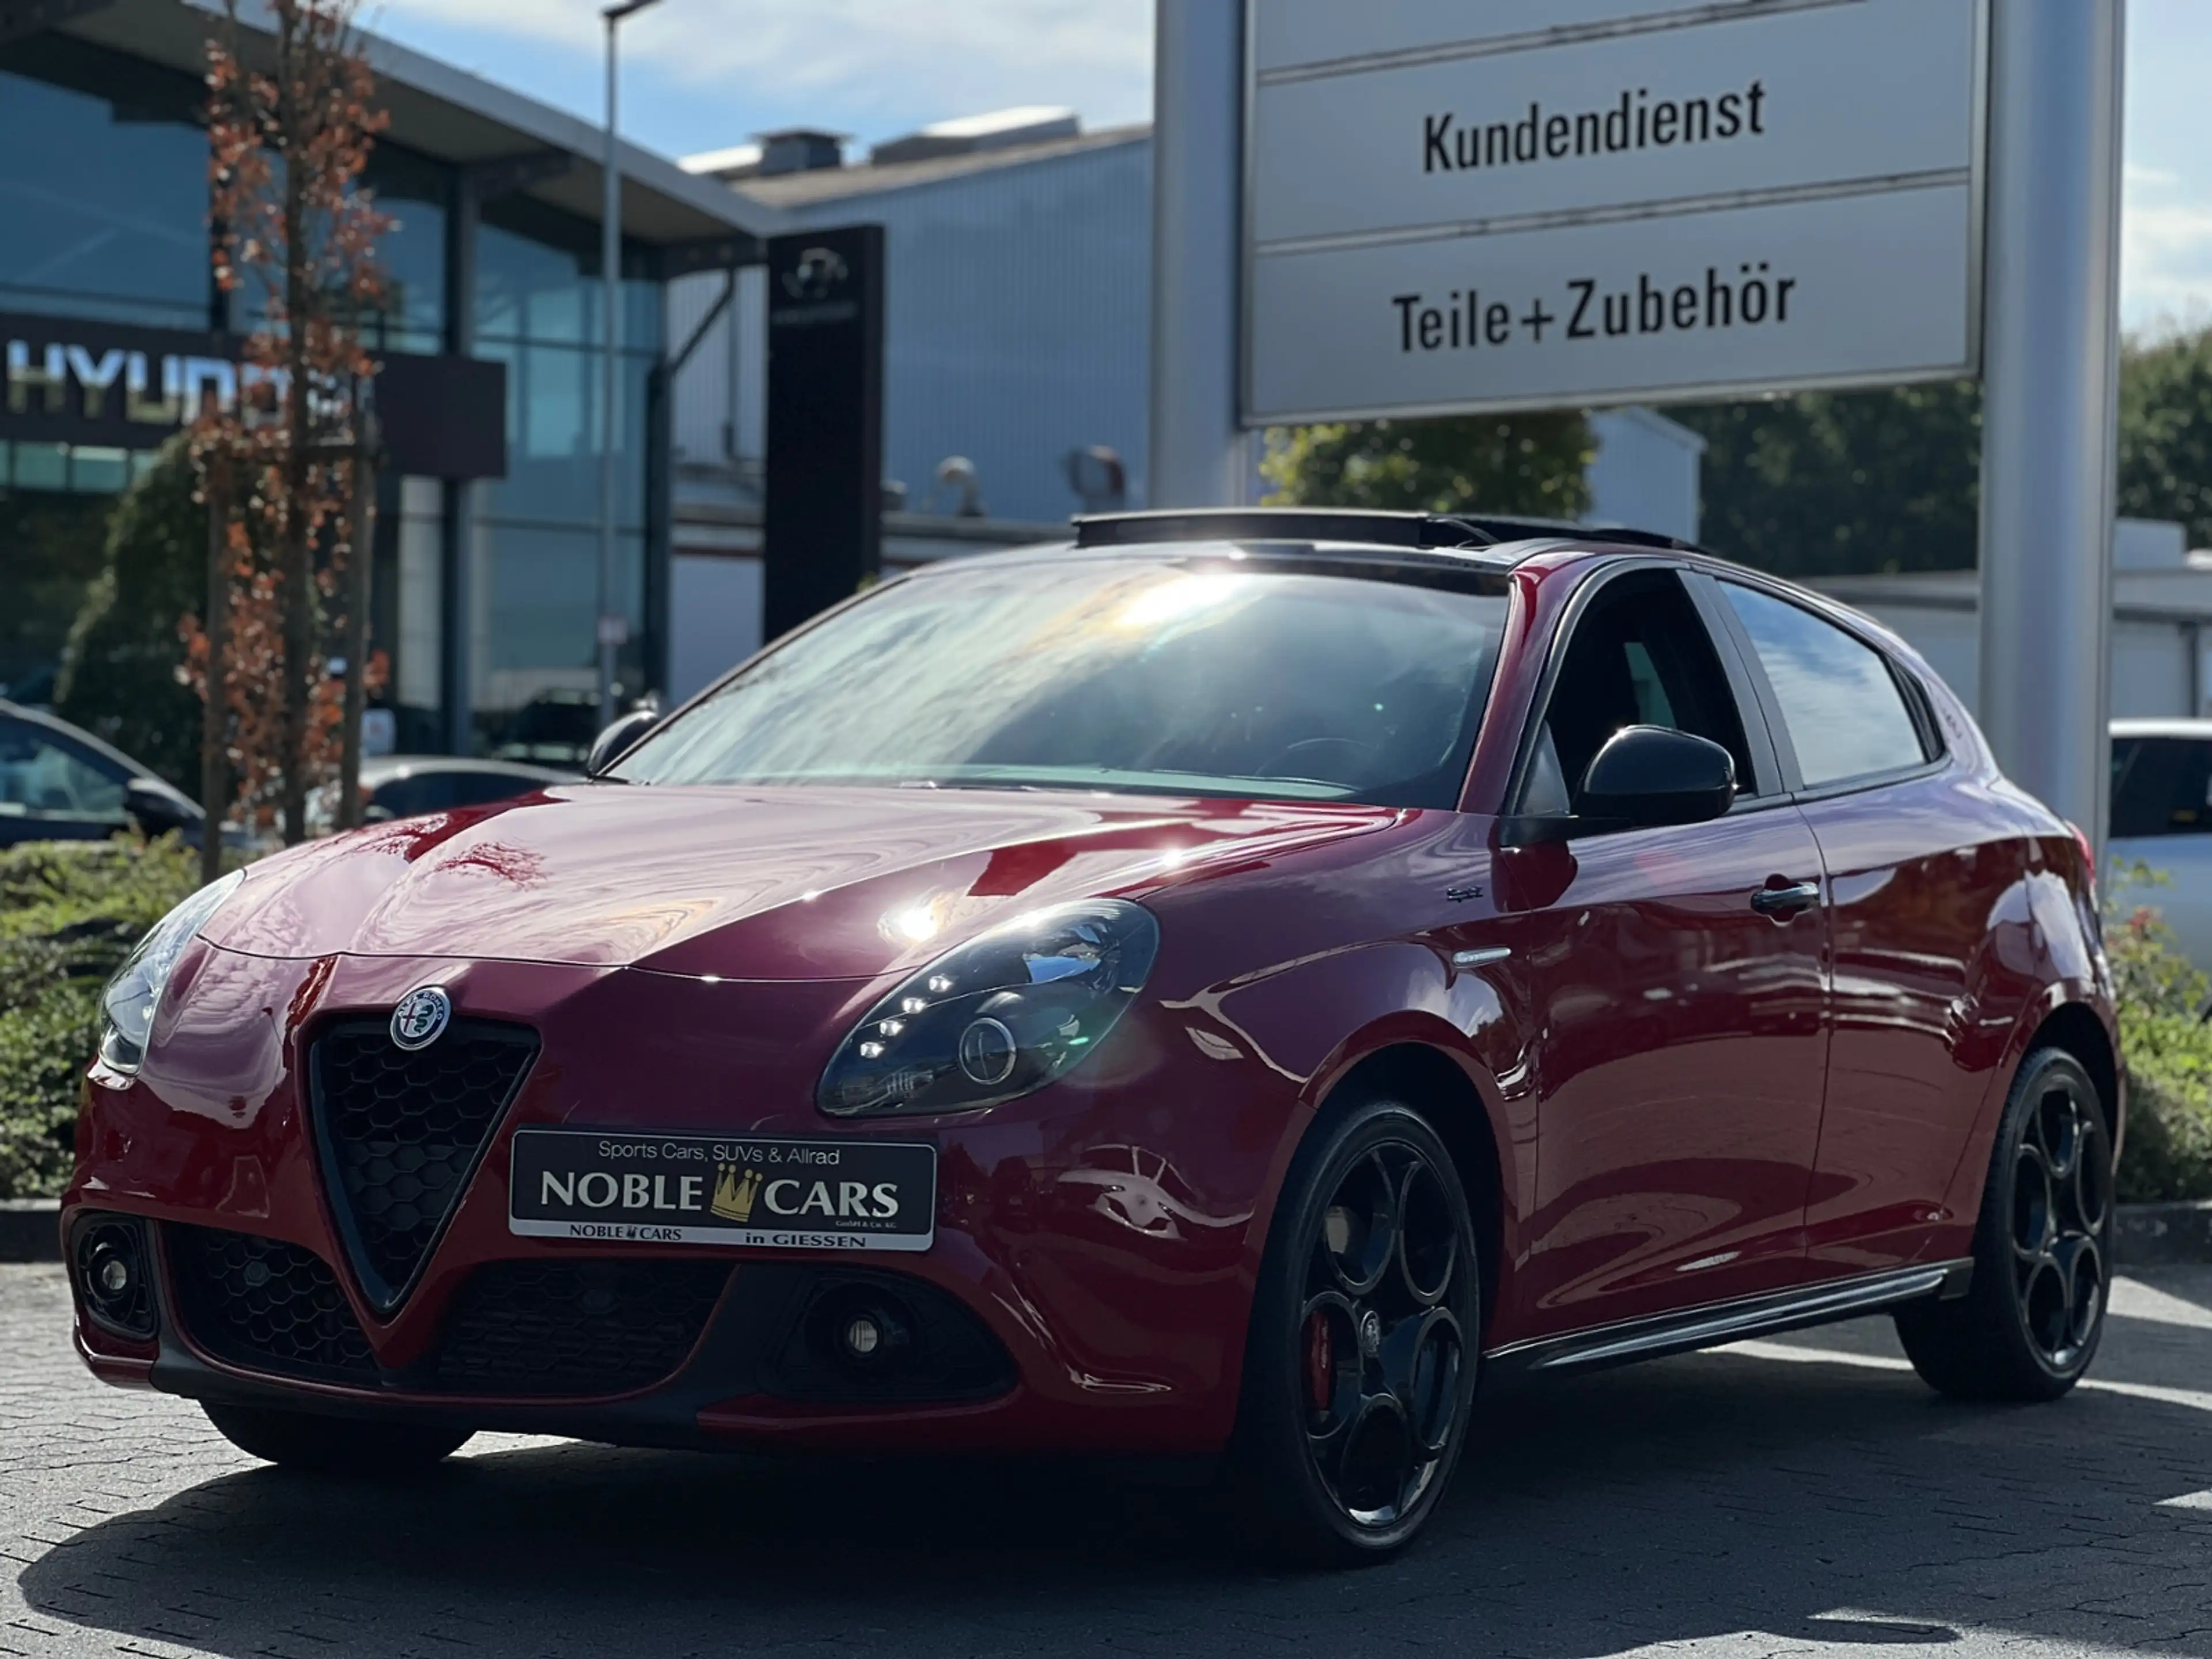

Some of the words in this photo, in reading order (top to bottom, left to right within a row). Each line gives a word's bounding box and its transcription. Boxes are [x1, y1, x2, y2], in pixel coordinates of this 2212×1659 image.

[1423, 80, 1765, 173] Kundendienst
[599, 1141, 657, 1160] Sports
[662, 1143, 708, 1162] Cars,
[713, 1145, 763, 1162] SUVs
[768, 1147, 782, 1163] &
[787, 1147, 840, 1165] Allrad
[541, 1171, 703, 1211] NOBLE
[764, 1179, 898, 1218] CARS
[570, 1225, 623, 1238] NOBLE
[639, 1228, 682, 1241] CARS
[745, 1232, 765, 1244] in
[772, 1233, 866, 1247] GIESSEN
